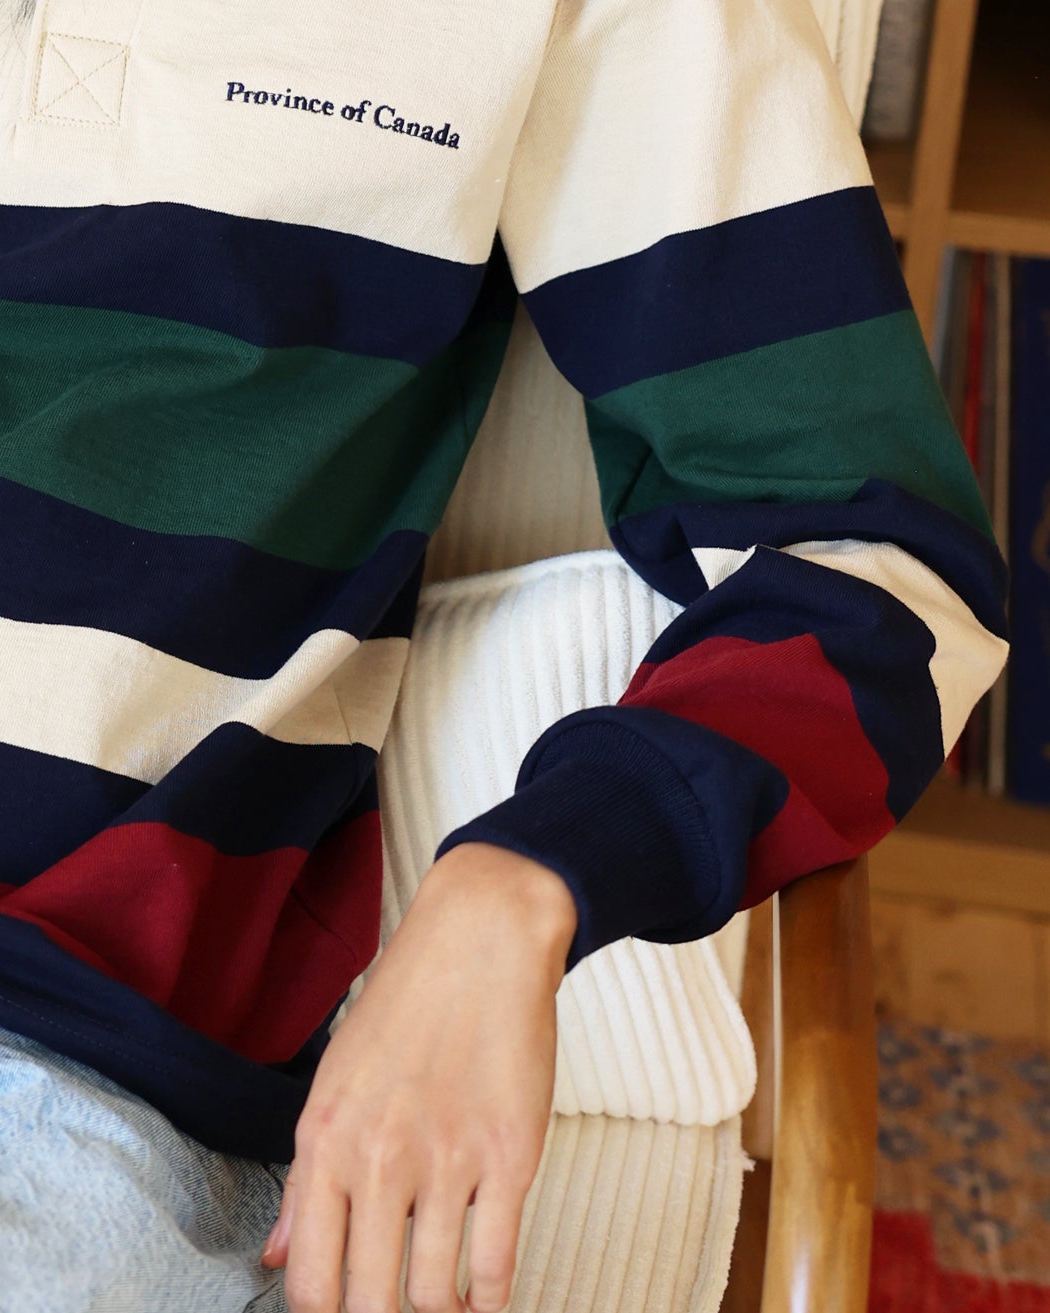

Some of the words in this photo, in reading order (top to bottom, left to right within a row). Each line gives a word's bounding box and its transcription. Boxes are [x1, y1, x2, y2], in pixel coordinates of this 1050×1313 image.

[225, 81, 334, 116] Province
[341, 100, 371, 123] of
[373, 105, 461, 149] Canada
